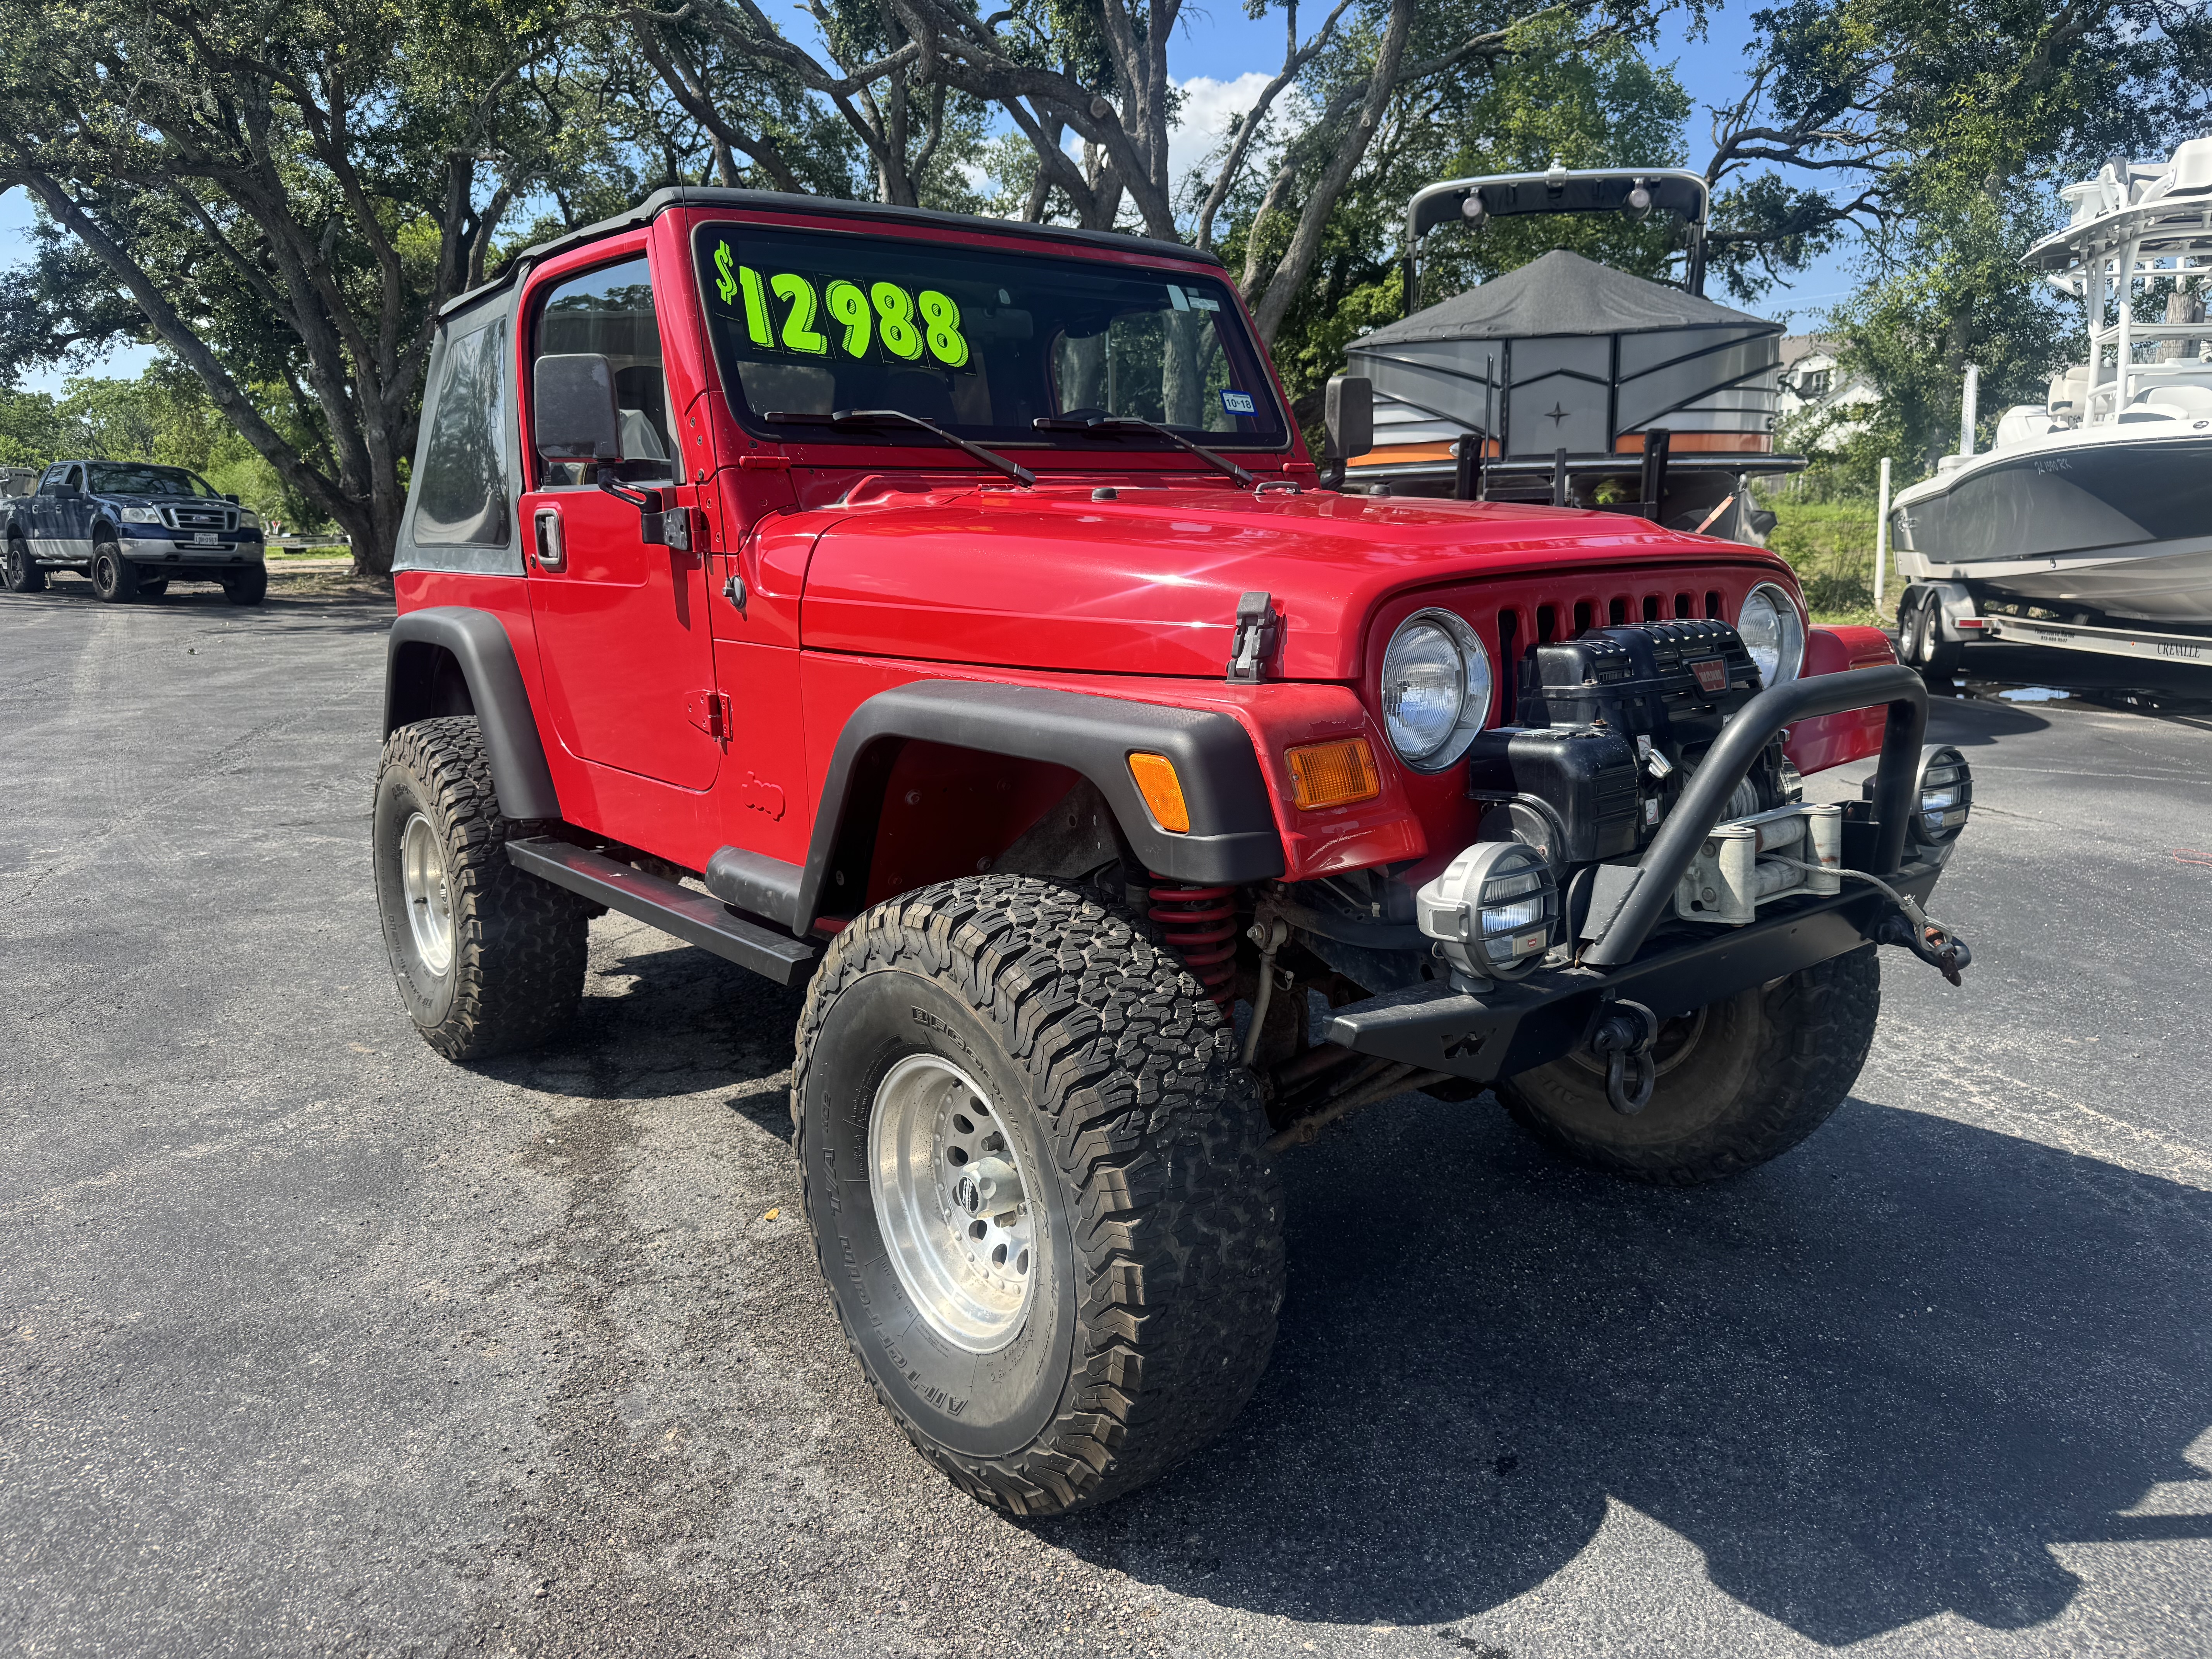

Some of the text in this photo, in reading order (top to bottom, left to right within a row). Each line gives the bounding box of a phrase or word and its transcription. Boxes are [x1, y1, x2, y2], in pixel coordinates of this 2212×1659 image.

[714, 239, 970, 368] $12988
[1226, 398, 1252, 409] 10 18
[1698, 669, 1723, 682] WARN
